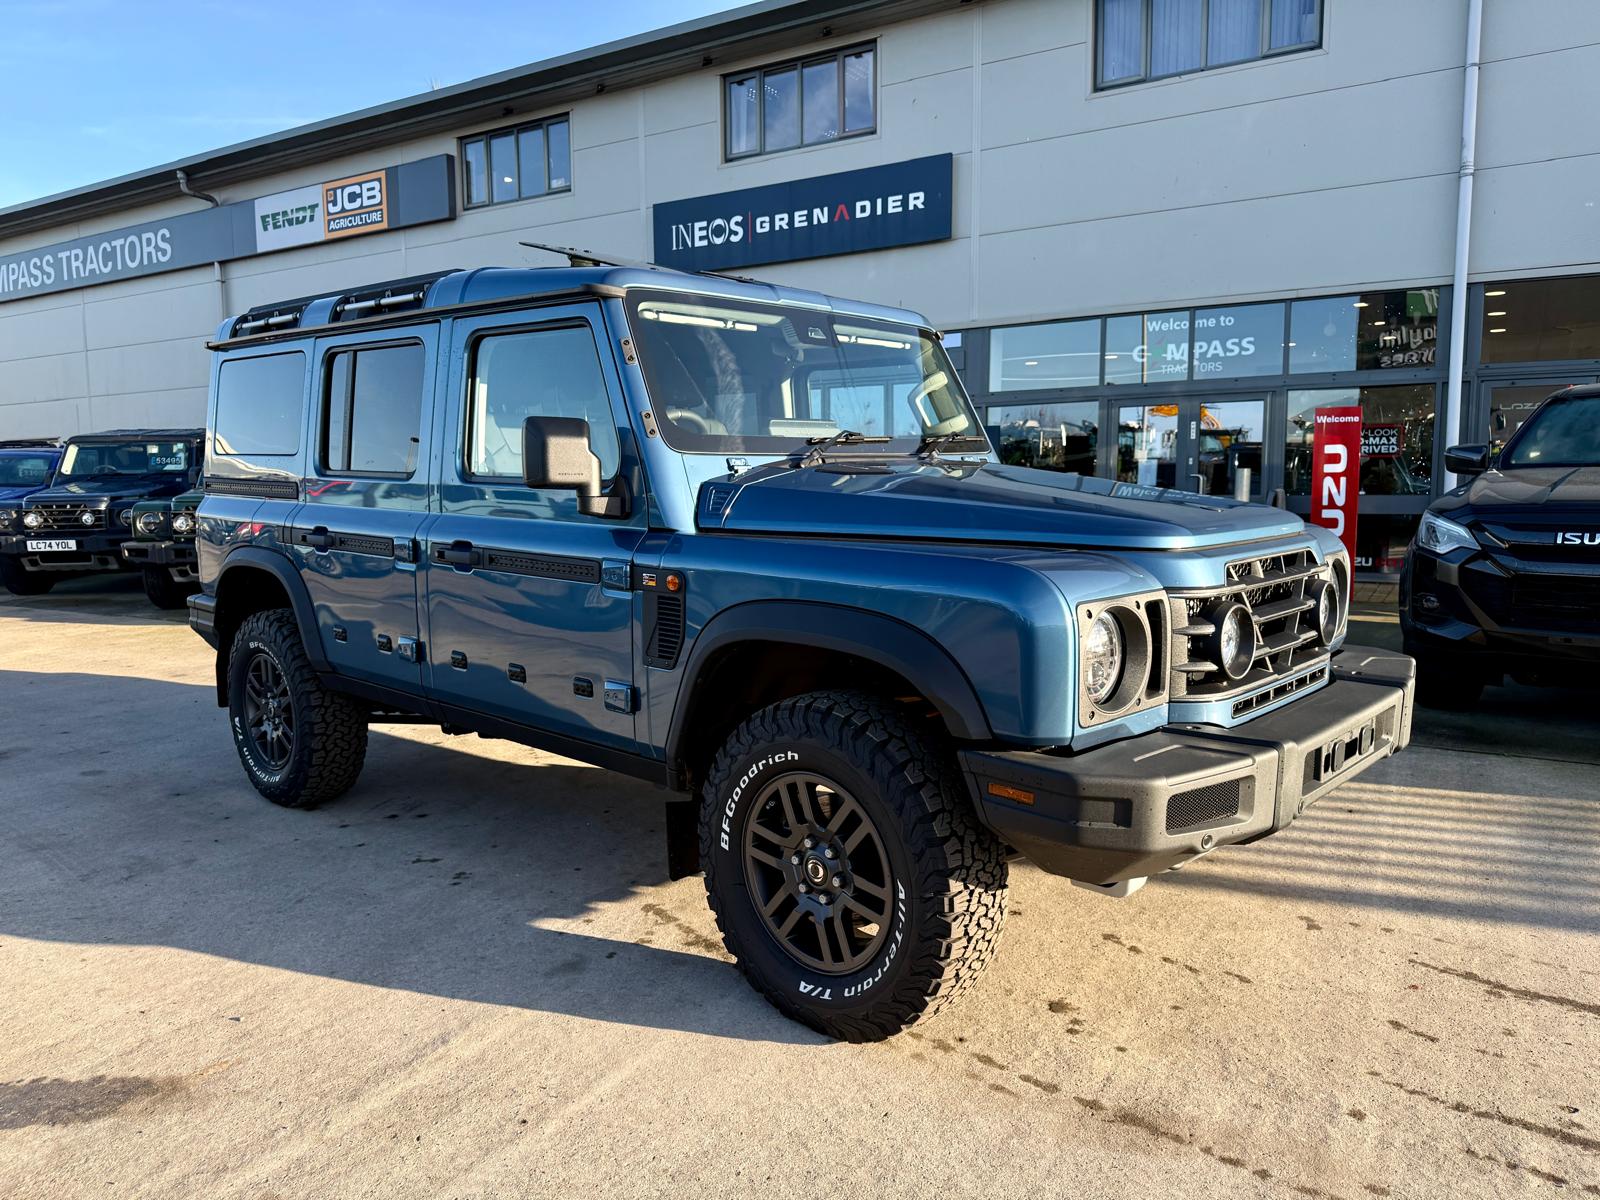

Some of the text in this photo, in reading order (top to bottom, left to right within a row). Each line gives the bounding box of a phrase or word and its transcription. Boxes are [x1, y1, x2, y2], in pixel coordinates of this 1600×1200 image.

[327, 180, 382, 214] JCB
[260, 202, 319, 232] FENDT
[328, 210, 382, 231] AGRICULTURE
[671, 191, 926, 251] INEOS GRENADIER
[57, 228, 172, 281] TRACTORS
[1147, 315, 1235, 332] Welcome to
[1132, 336, 1256, 363] CMPASS
[1316, 415, 1360, 423] Welcome
[30, 541, 53, 550] LC74
[720, 750, 799, 851] BFGoodrich
[798, 980, 833, 1000] T/A
